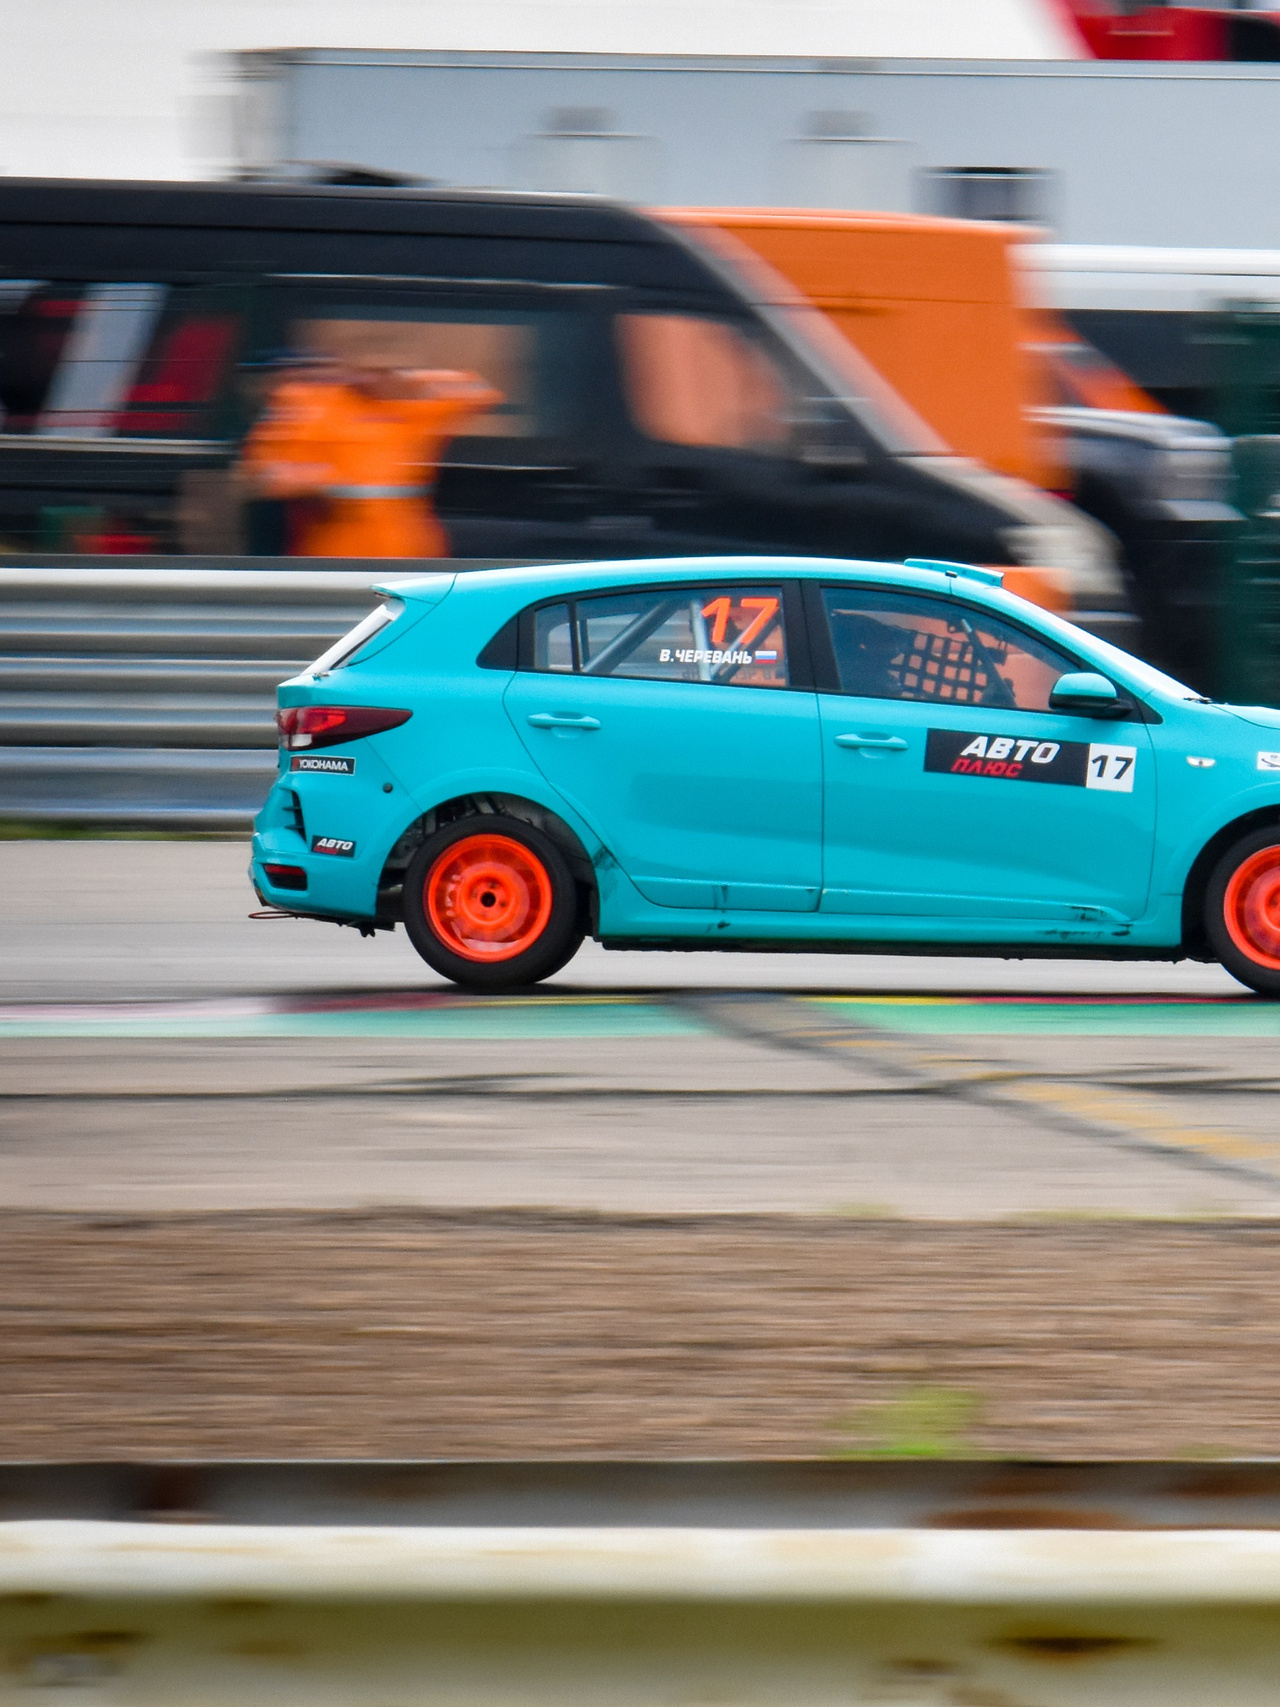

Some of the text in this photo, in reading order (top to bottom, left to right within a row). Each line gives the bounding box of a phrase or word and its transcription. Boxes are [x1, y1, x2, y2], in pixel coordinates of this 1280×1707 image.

[701, 596, 779, 644] 17
[660, 649, 752, 664] В.ЧЕРЕВАНЬ
[960, 736, 1061, 764] АВТО
[299, 759, 349, 771] YOKOHAMA
[951, 757, 1024, 778] ПЛЮС
[1091, 754, 1134, 780] 17
[317, 838, 354, 850] АВТО
